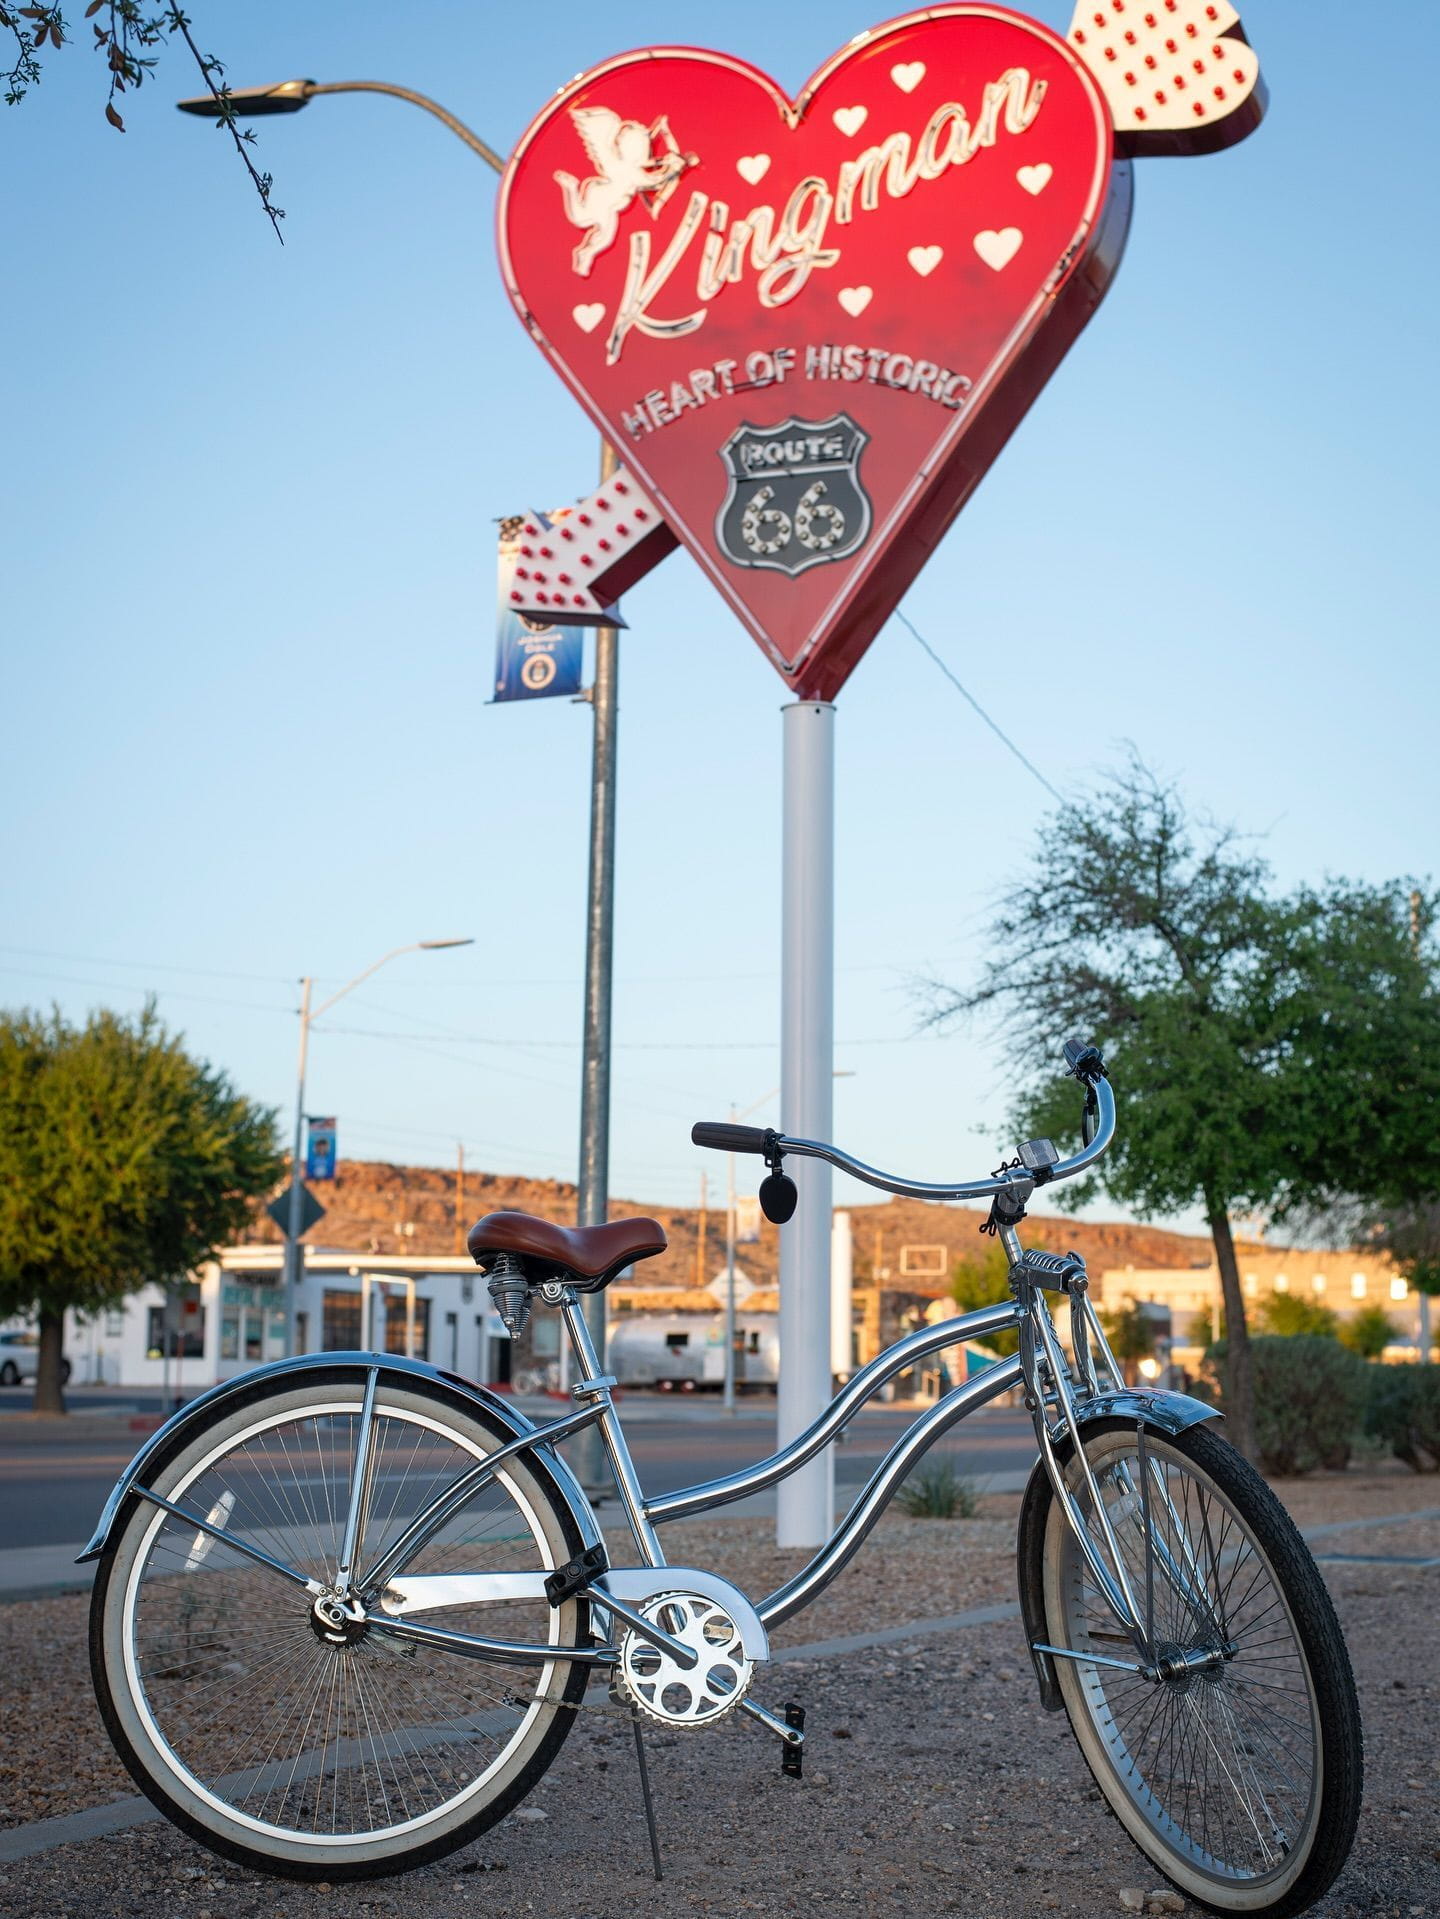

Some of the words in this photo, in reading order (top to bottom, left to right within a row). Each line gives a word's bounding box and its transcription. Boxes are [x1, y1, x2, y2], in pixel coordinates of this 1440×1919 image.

[606, 67, 1048, 366] Kingman
[621, 358, 737, 441] HEART
[745, 347, 797, 387] OF
[805, 344, 972, 410] HISTORIC
[740, 435, 844, 465] ROUTE
[741, 480, 845, 554] 66
